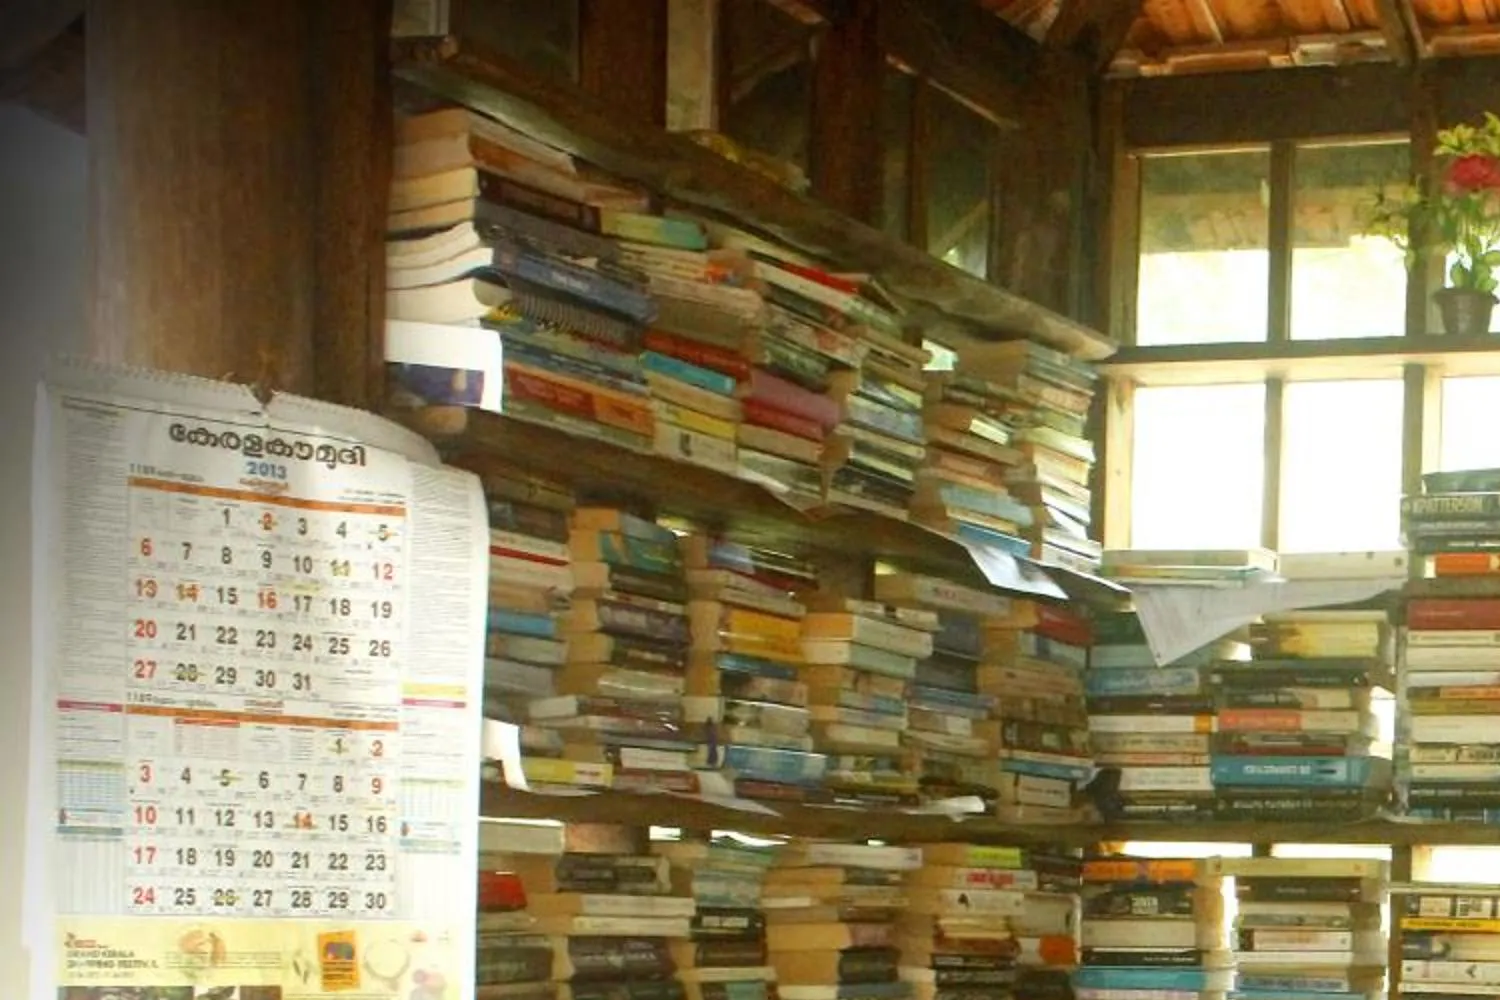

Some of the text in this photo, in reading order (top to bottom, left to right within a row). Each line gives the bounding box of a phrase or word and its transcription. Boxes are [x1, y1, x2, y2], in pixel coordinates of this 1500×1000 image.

[246, 461, 287, 480] 2013
[224, 508, 230, 525] 1
[263, 513, 272, 530] 2
[298, 518, 307, 535] 3
[336, 521, 347, 538] 4
[141, 538, 152, 556] 6
[182, 543, 192, 560] 7
[222, 547, 232, 564] 8
[261, 550, 272, 568] 9
[294, 556, 312, 574] 10
[373, 563, 393, 580] 12
[135, 580, 157, 598] 13
[217, 587, 238, 605] 15
[257, 591, 277, 609] 16
[294, 595, 312, 612] 17
[330, 599, 351, 616] 18
[372, 601, 393, 618] 19
[134, 620, 391, 657] 20 21 22 23 24 25 26
[134, 660, 311, 691] 27 28 29 30 31
[335, 738, 383, 757] 1 2
[140, 765, 383, 795] 3 4 5 6 7 8 9
[135, 806, 156, 825] 10
[177, 808, 195, 826] 11
[215, 809, 235, 827] 12
[254, 811, 274, 828] 13
[329, 814, 348, 831] 15
[367, 816, 387, 833] 16
[134, 846, 386, 871] 17 18 19 20 21 22 23
[133, 886, 155, 905] 24
[174, 887, 196, 906] 25
[253, 888, 273, 907] 27
[291, 890, 311, 909] 28
[328, 891, 348, 909] 29
[365, 892, 386, 910] 30
